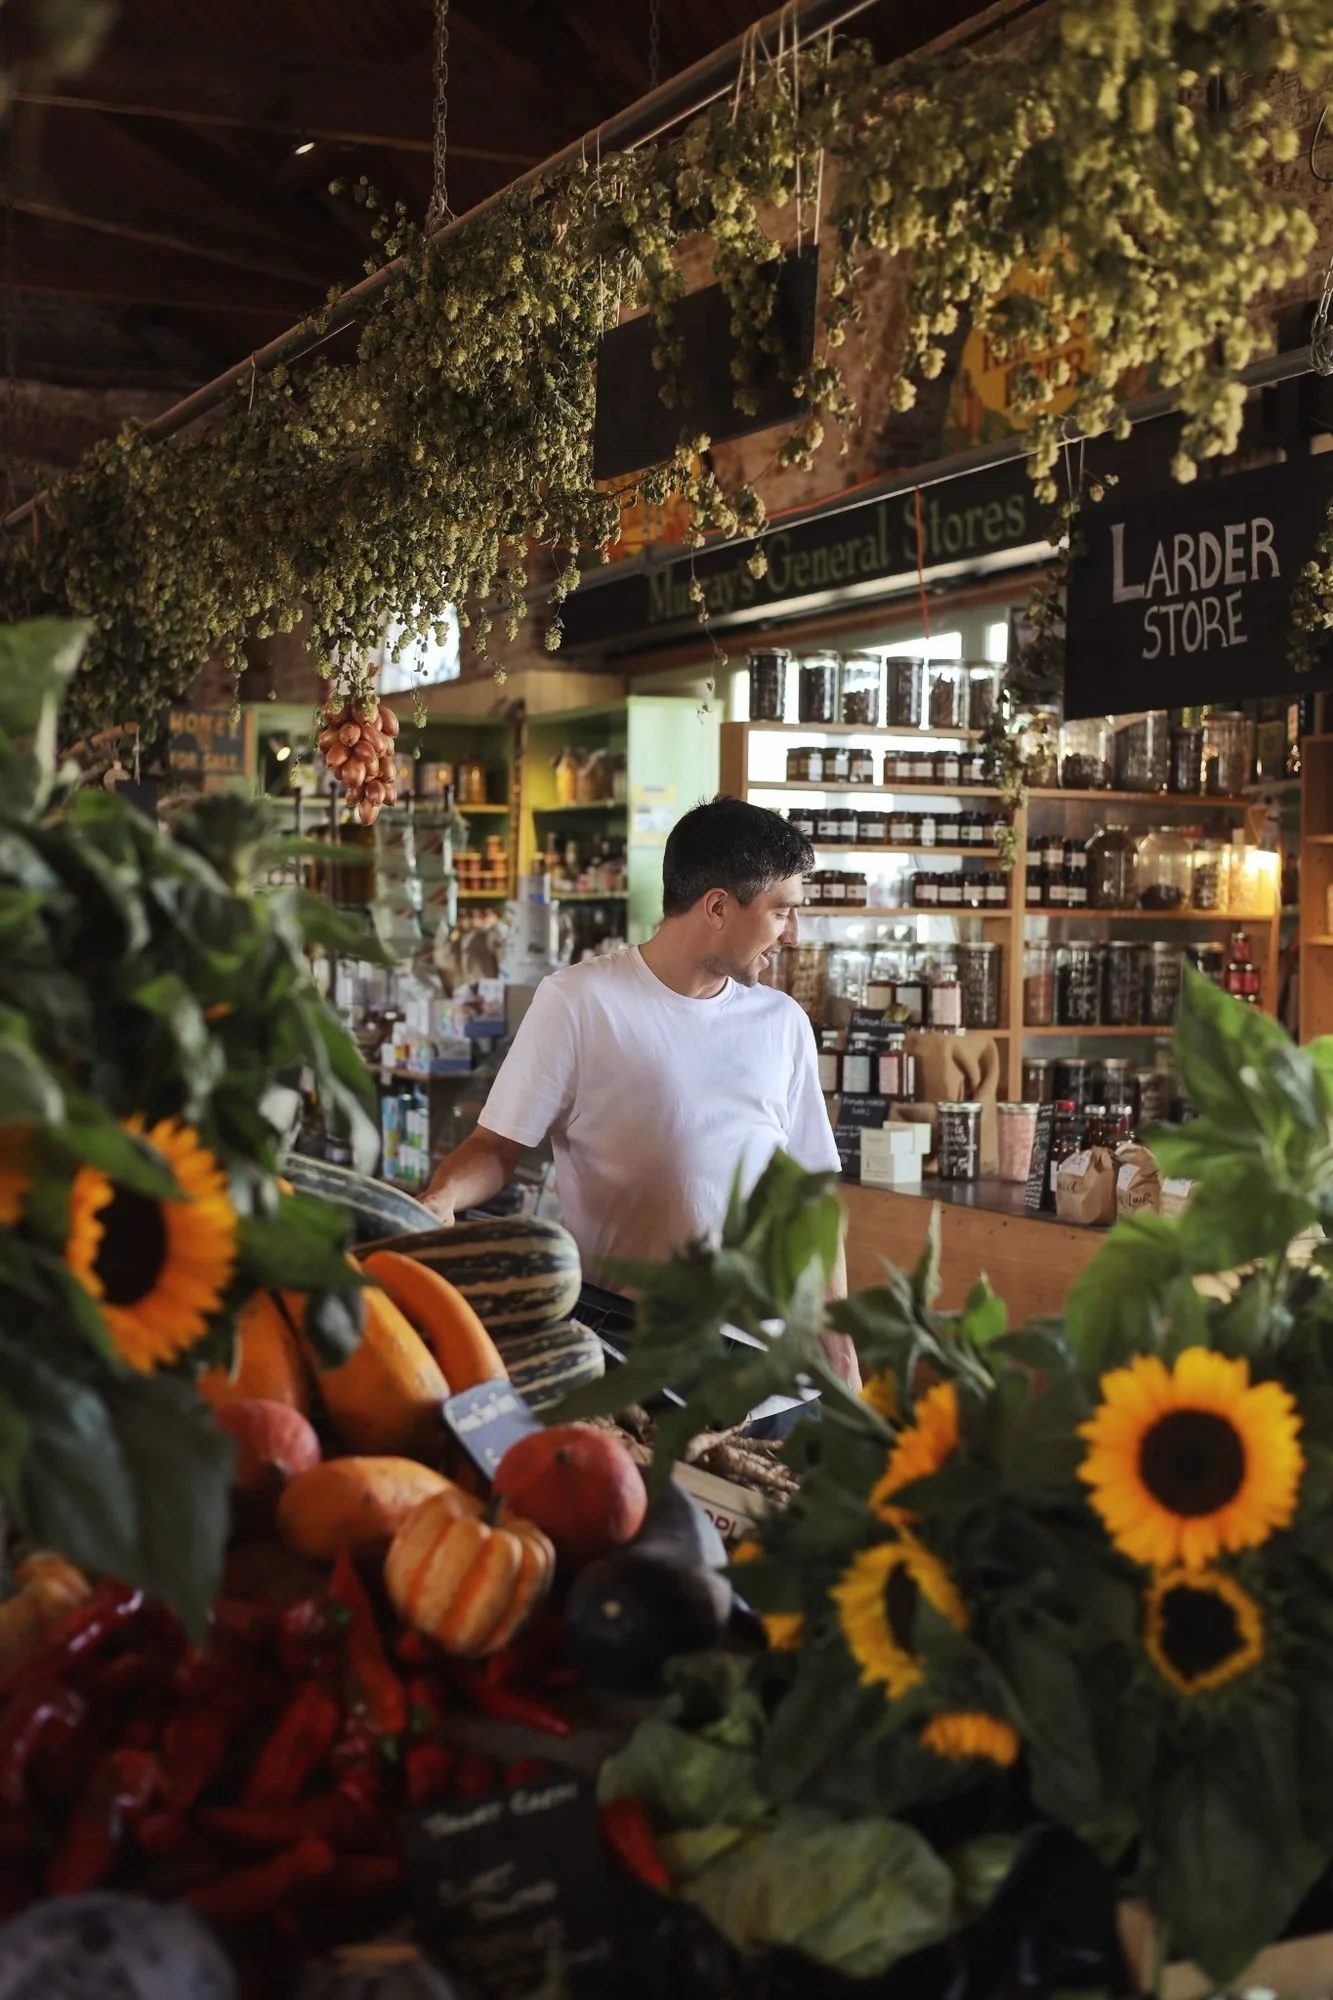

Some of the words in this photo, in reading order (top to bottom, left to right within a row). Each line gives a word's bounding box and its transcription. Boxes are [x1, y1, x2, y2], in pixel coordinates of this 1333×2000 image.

[648, 559, 757, 624] Muray's
[766, 503, 891, 593] General
[903, 495, 1027, 560] Stores
[1110, 517, 1281, 604] LARDER
[1141, 589, 1248, 660] STORE
